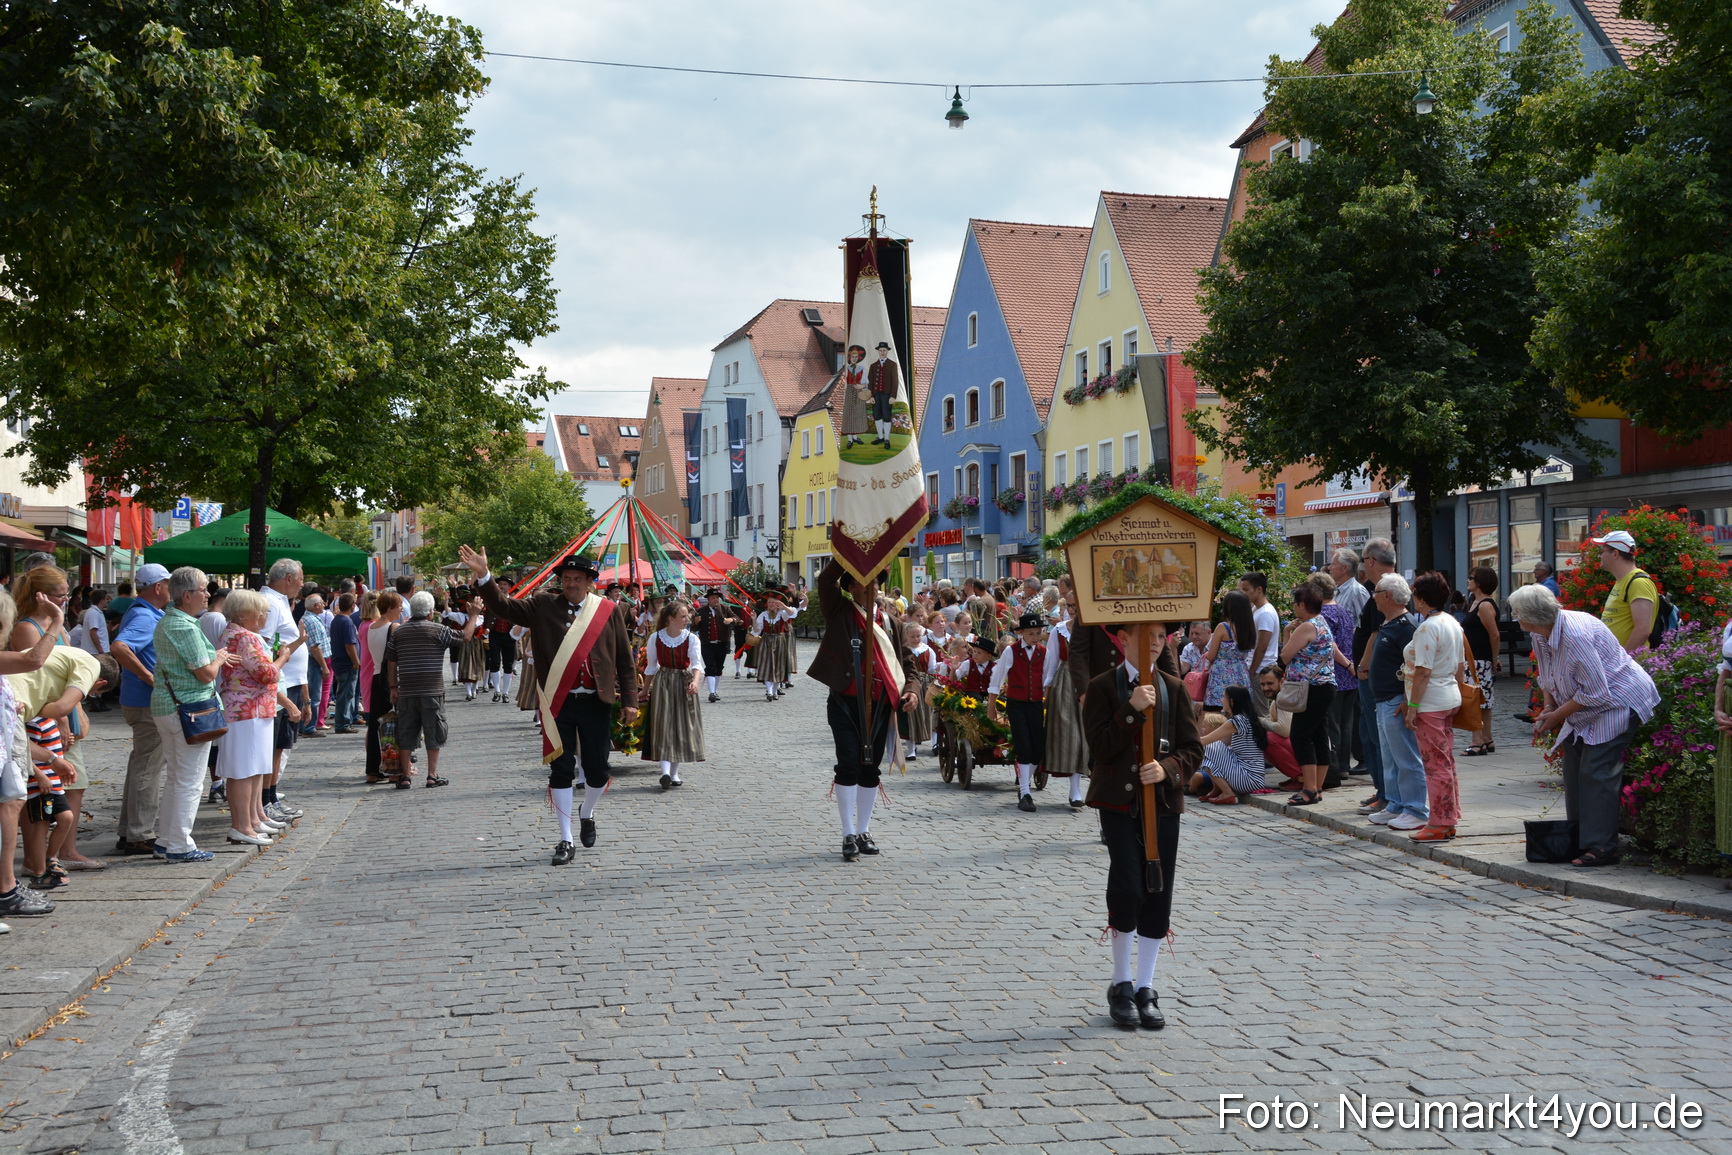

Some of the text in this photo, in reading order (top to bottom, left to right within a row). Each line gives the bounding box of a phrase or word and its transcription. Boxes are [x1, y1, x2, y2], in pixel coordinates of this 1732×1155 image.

[732, 439, 746, 473] K&L
[809, 472, 824, 487] HOTEL
[176, 500, 187, 517] P
[1120, 514, 1162, 531] Heimat
[1091, 530, 1197, 543] Volkstrachtenverein
[808, 541, 829, 551] Restaurant
[1112, 600, 1179, 616] Sindlbach
